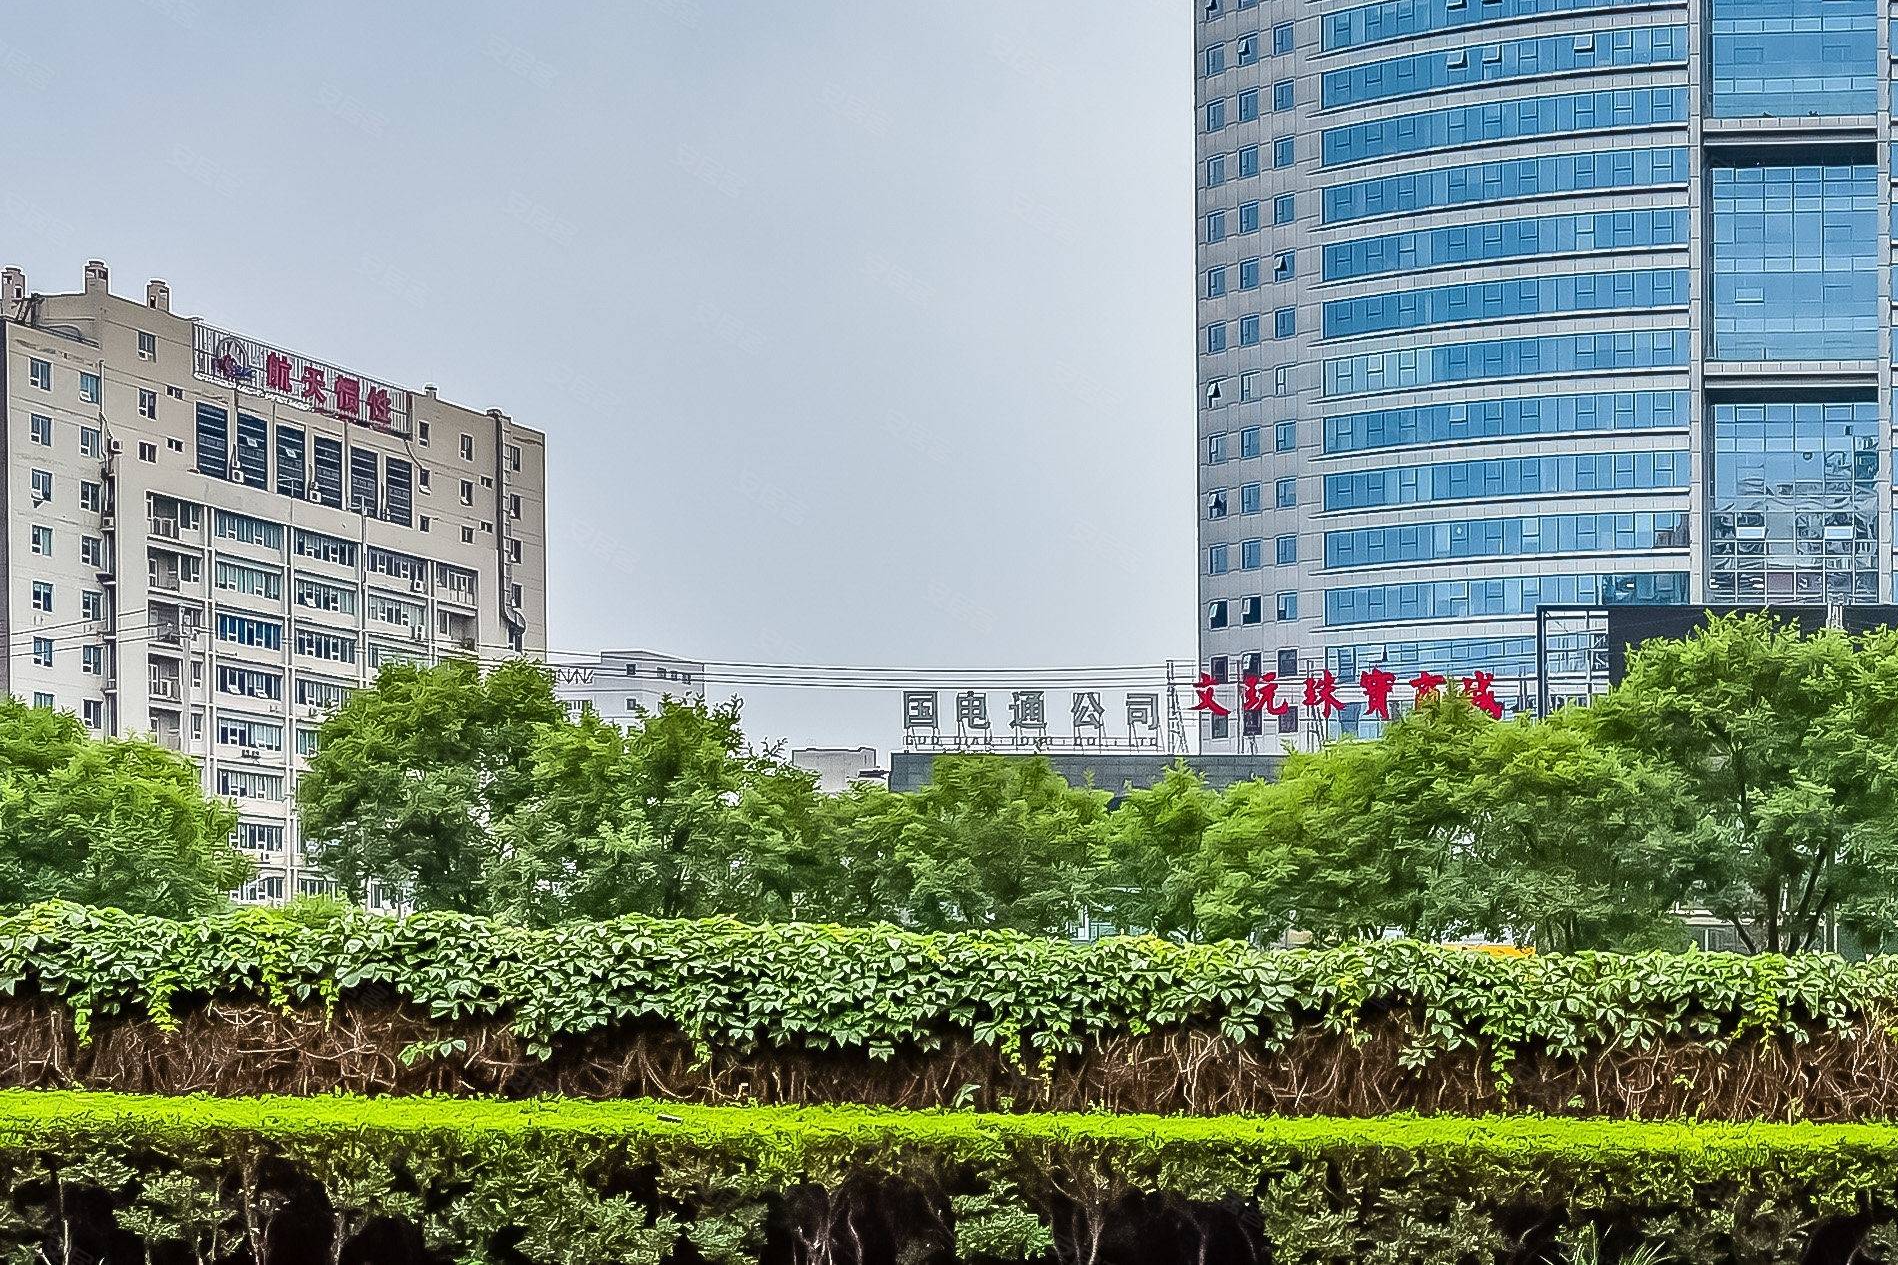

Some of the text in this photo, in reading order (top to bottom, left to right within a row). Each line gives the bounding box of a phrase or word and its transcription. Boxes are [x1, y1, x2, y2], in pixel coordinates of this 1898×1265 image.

[903, 690, 1159, 730] 国电通公司
